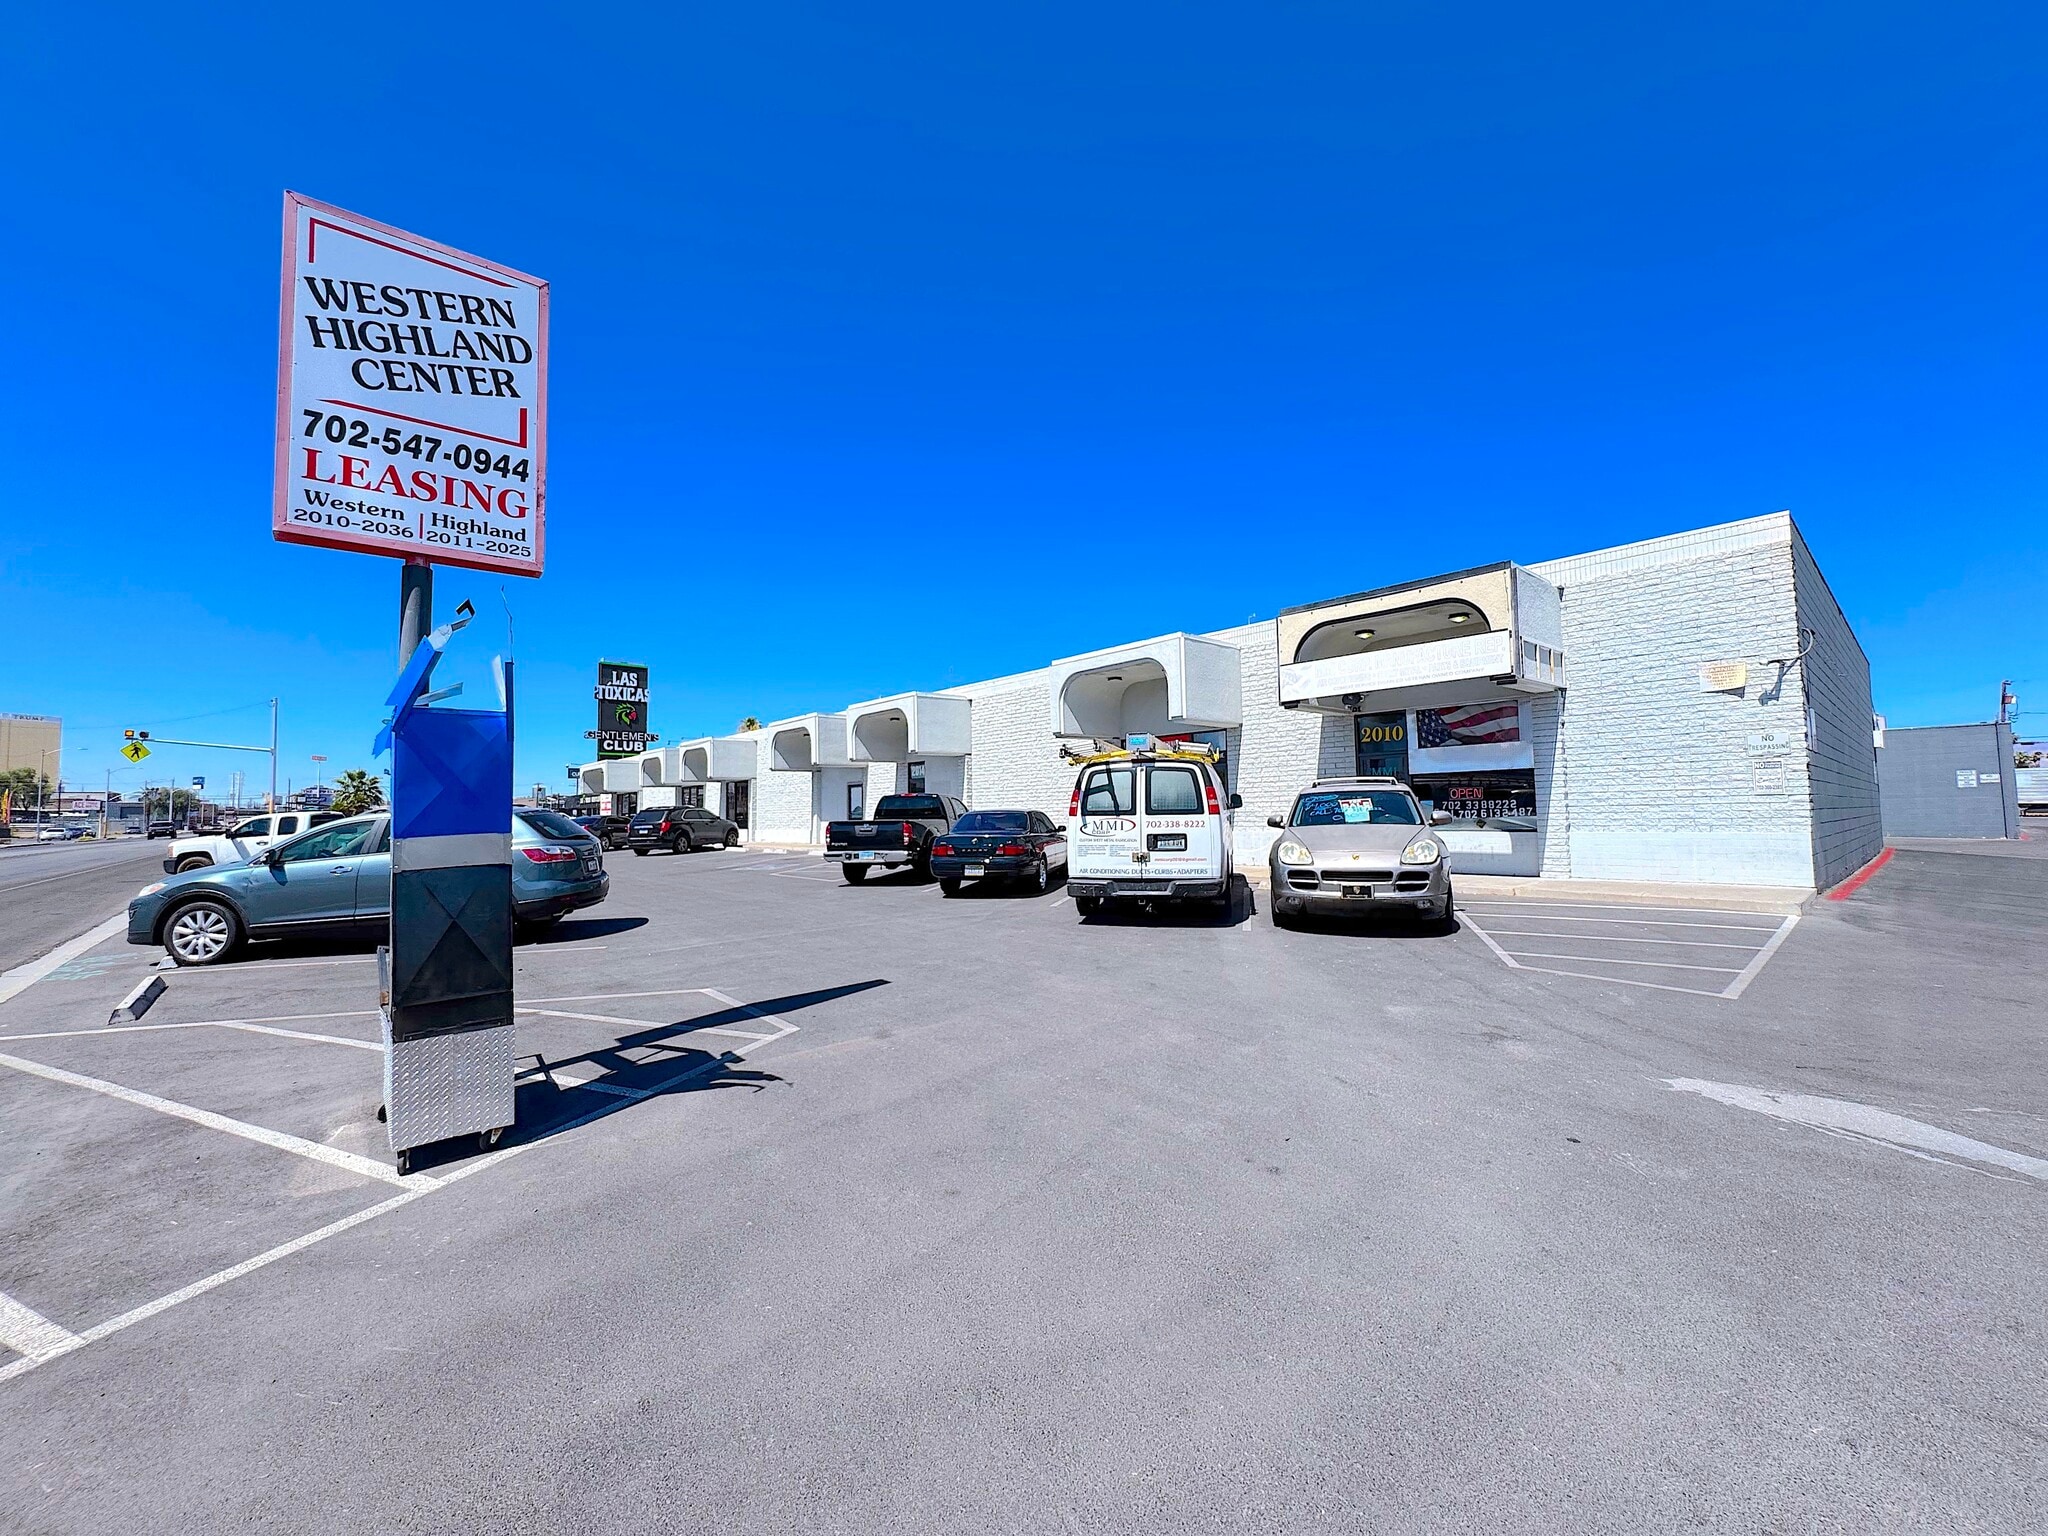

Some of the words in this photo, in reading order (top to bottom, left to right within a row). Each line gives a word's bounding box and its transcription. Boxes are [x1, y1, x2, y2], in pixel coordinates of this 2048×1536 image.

[303, 277, 517, 329] WESTERN
[304, 315, 533, 365] HIGHLAND
[351, 358, 521, 399] CENTER
[302, 409, 530, 483] 702-547-0944
[301, 447, 530, 520] LEASING
[303, 488, 406, 521] Western
[293, 508, 414, 539] 2010-2036
[431, 511, 527, 543] Highland
[426, 530, 532, 558] 2011-2025
[1474, 635, 1506, 656] REP.
[612, 671, 638, 687] LAS
[586, 730, 659, 742] GENTLEMEN'S
[1361, 725, 1404, 743] 2010
[1761, 734, 1775, 742] NO
[603, 740, 644, 752] CLUB
[1748, 741, 1790, 751] TRESPASSING
[1450, 787, 1482, 799] OPEN
[1442, 801, 1461, 810] 702
[1458, 810, 1478, 819] 702
[1092, 820, 1125, 831] MMI
[1145, 820, 1206, 828] 702-338-8222
